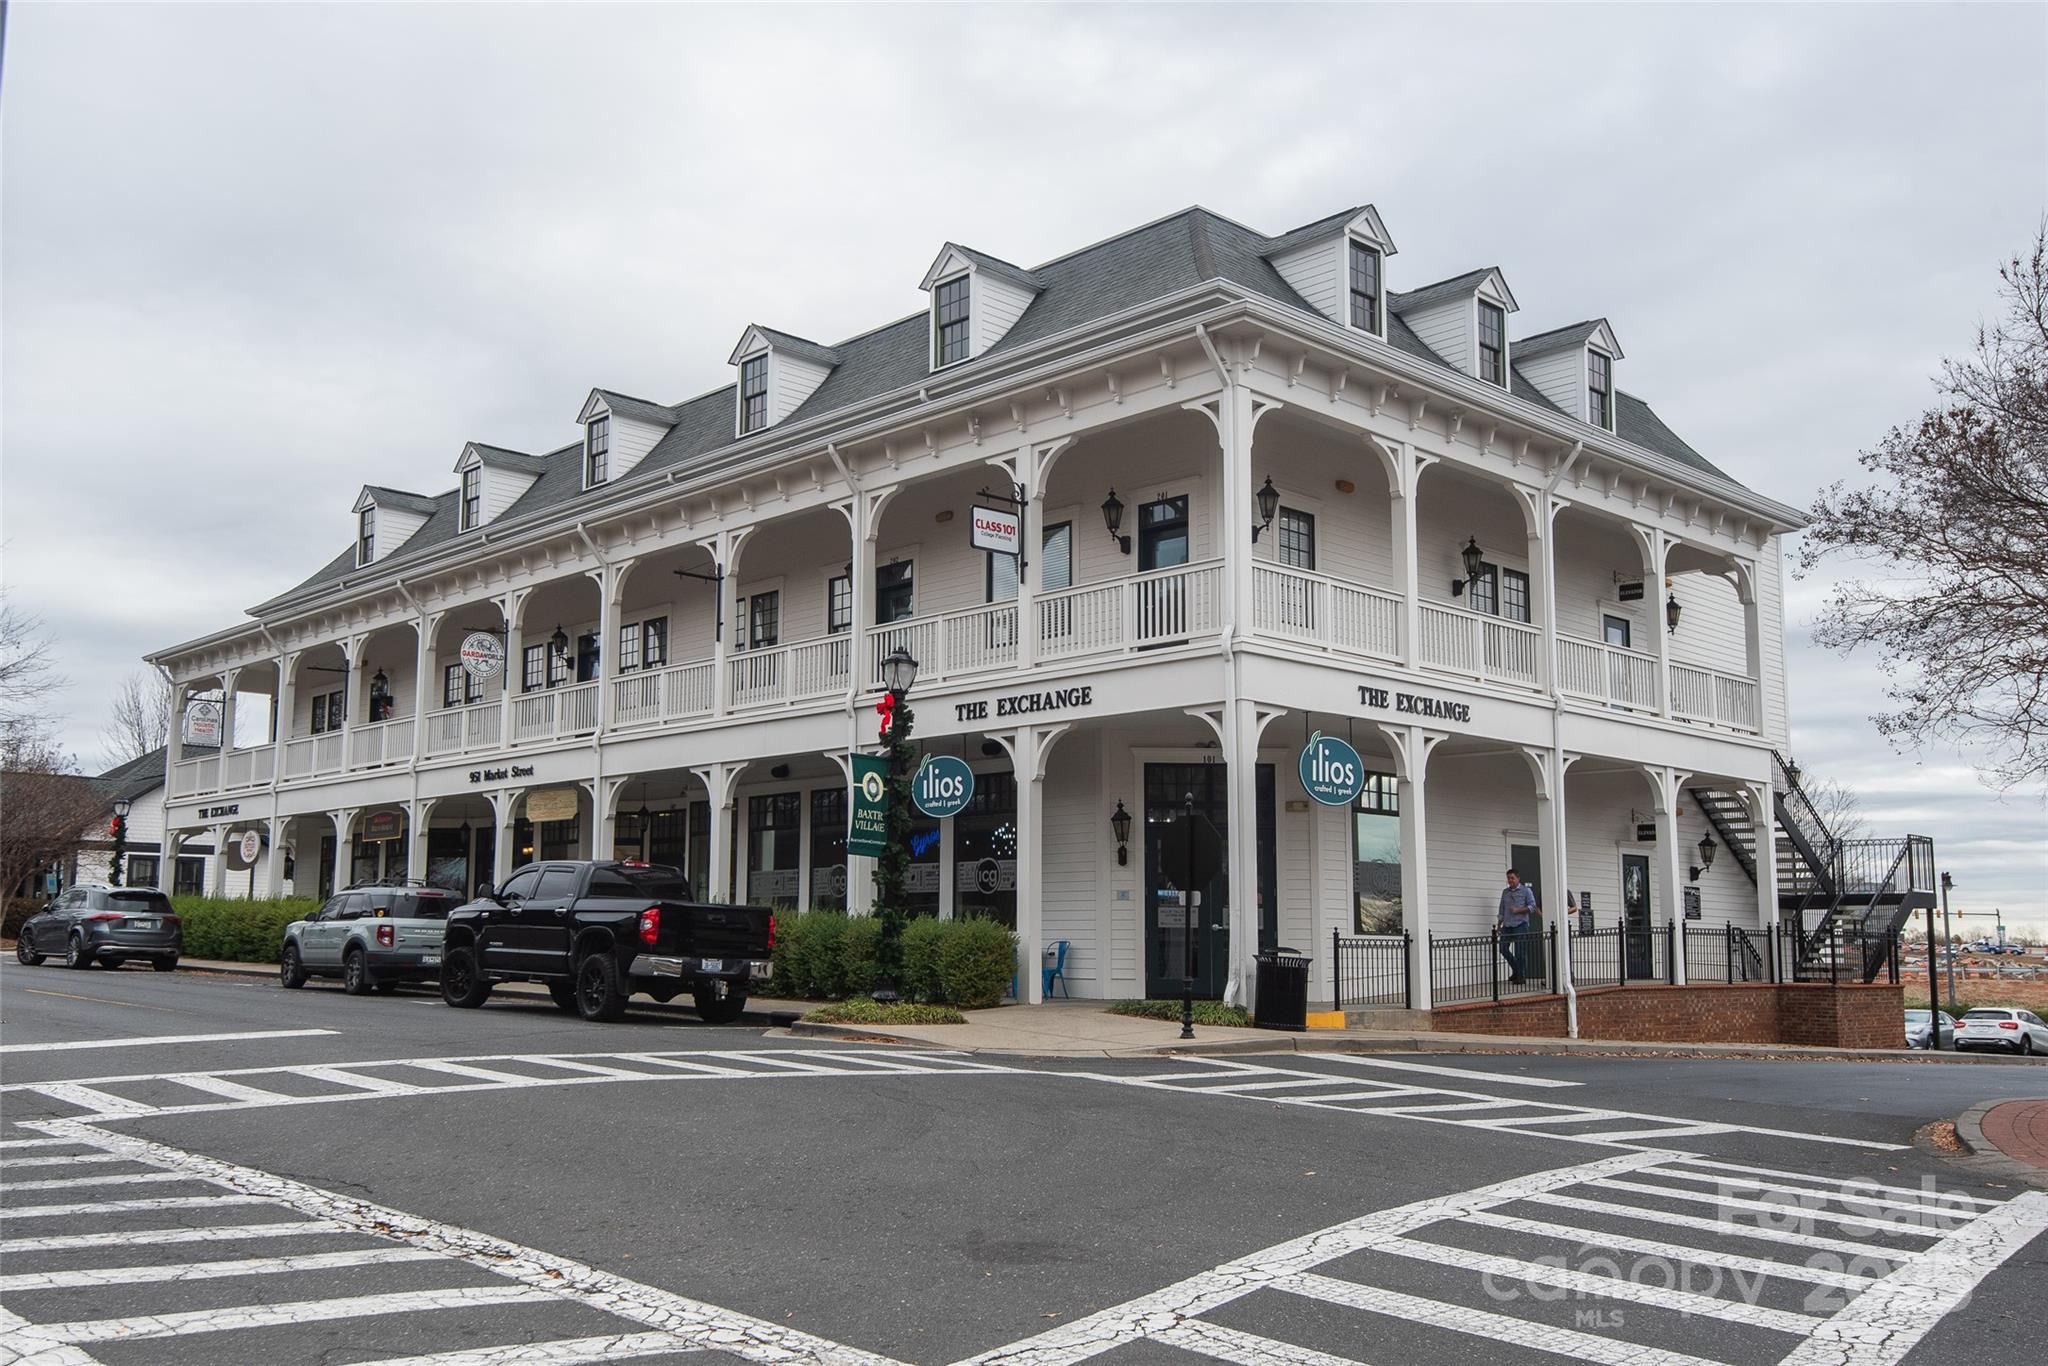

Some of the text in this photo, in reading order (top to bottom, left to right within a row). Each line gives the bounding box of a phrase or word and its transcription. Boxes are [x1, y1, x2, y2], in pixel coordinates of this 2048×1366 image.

[975, 518, 1016, 536] CLASS 101
[955, 686, 1092, 721] THE EXCHANGE
[1357, 685, 1471, 723] THE EXCHANGE
[484, 768, 508, 781] Market
[511, 764, 534, 778] Street
[1312, 743, 1355, 786] ilios
[923, 764, 964, 799] ilios
[1314, 784, 1353, 796] crafted greek
[857, 808, 884, 821] BAXTR
